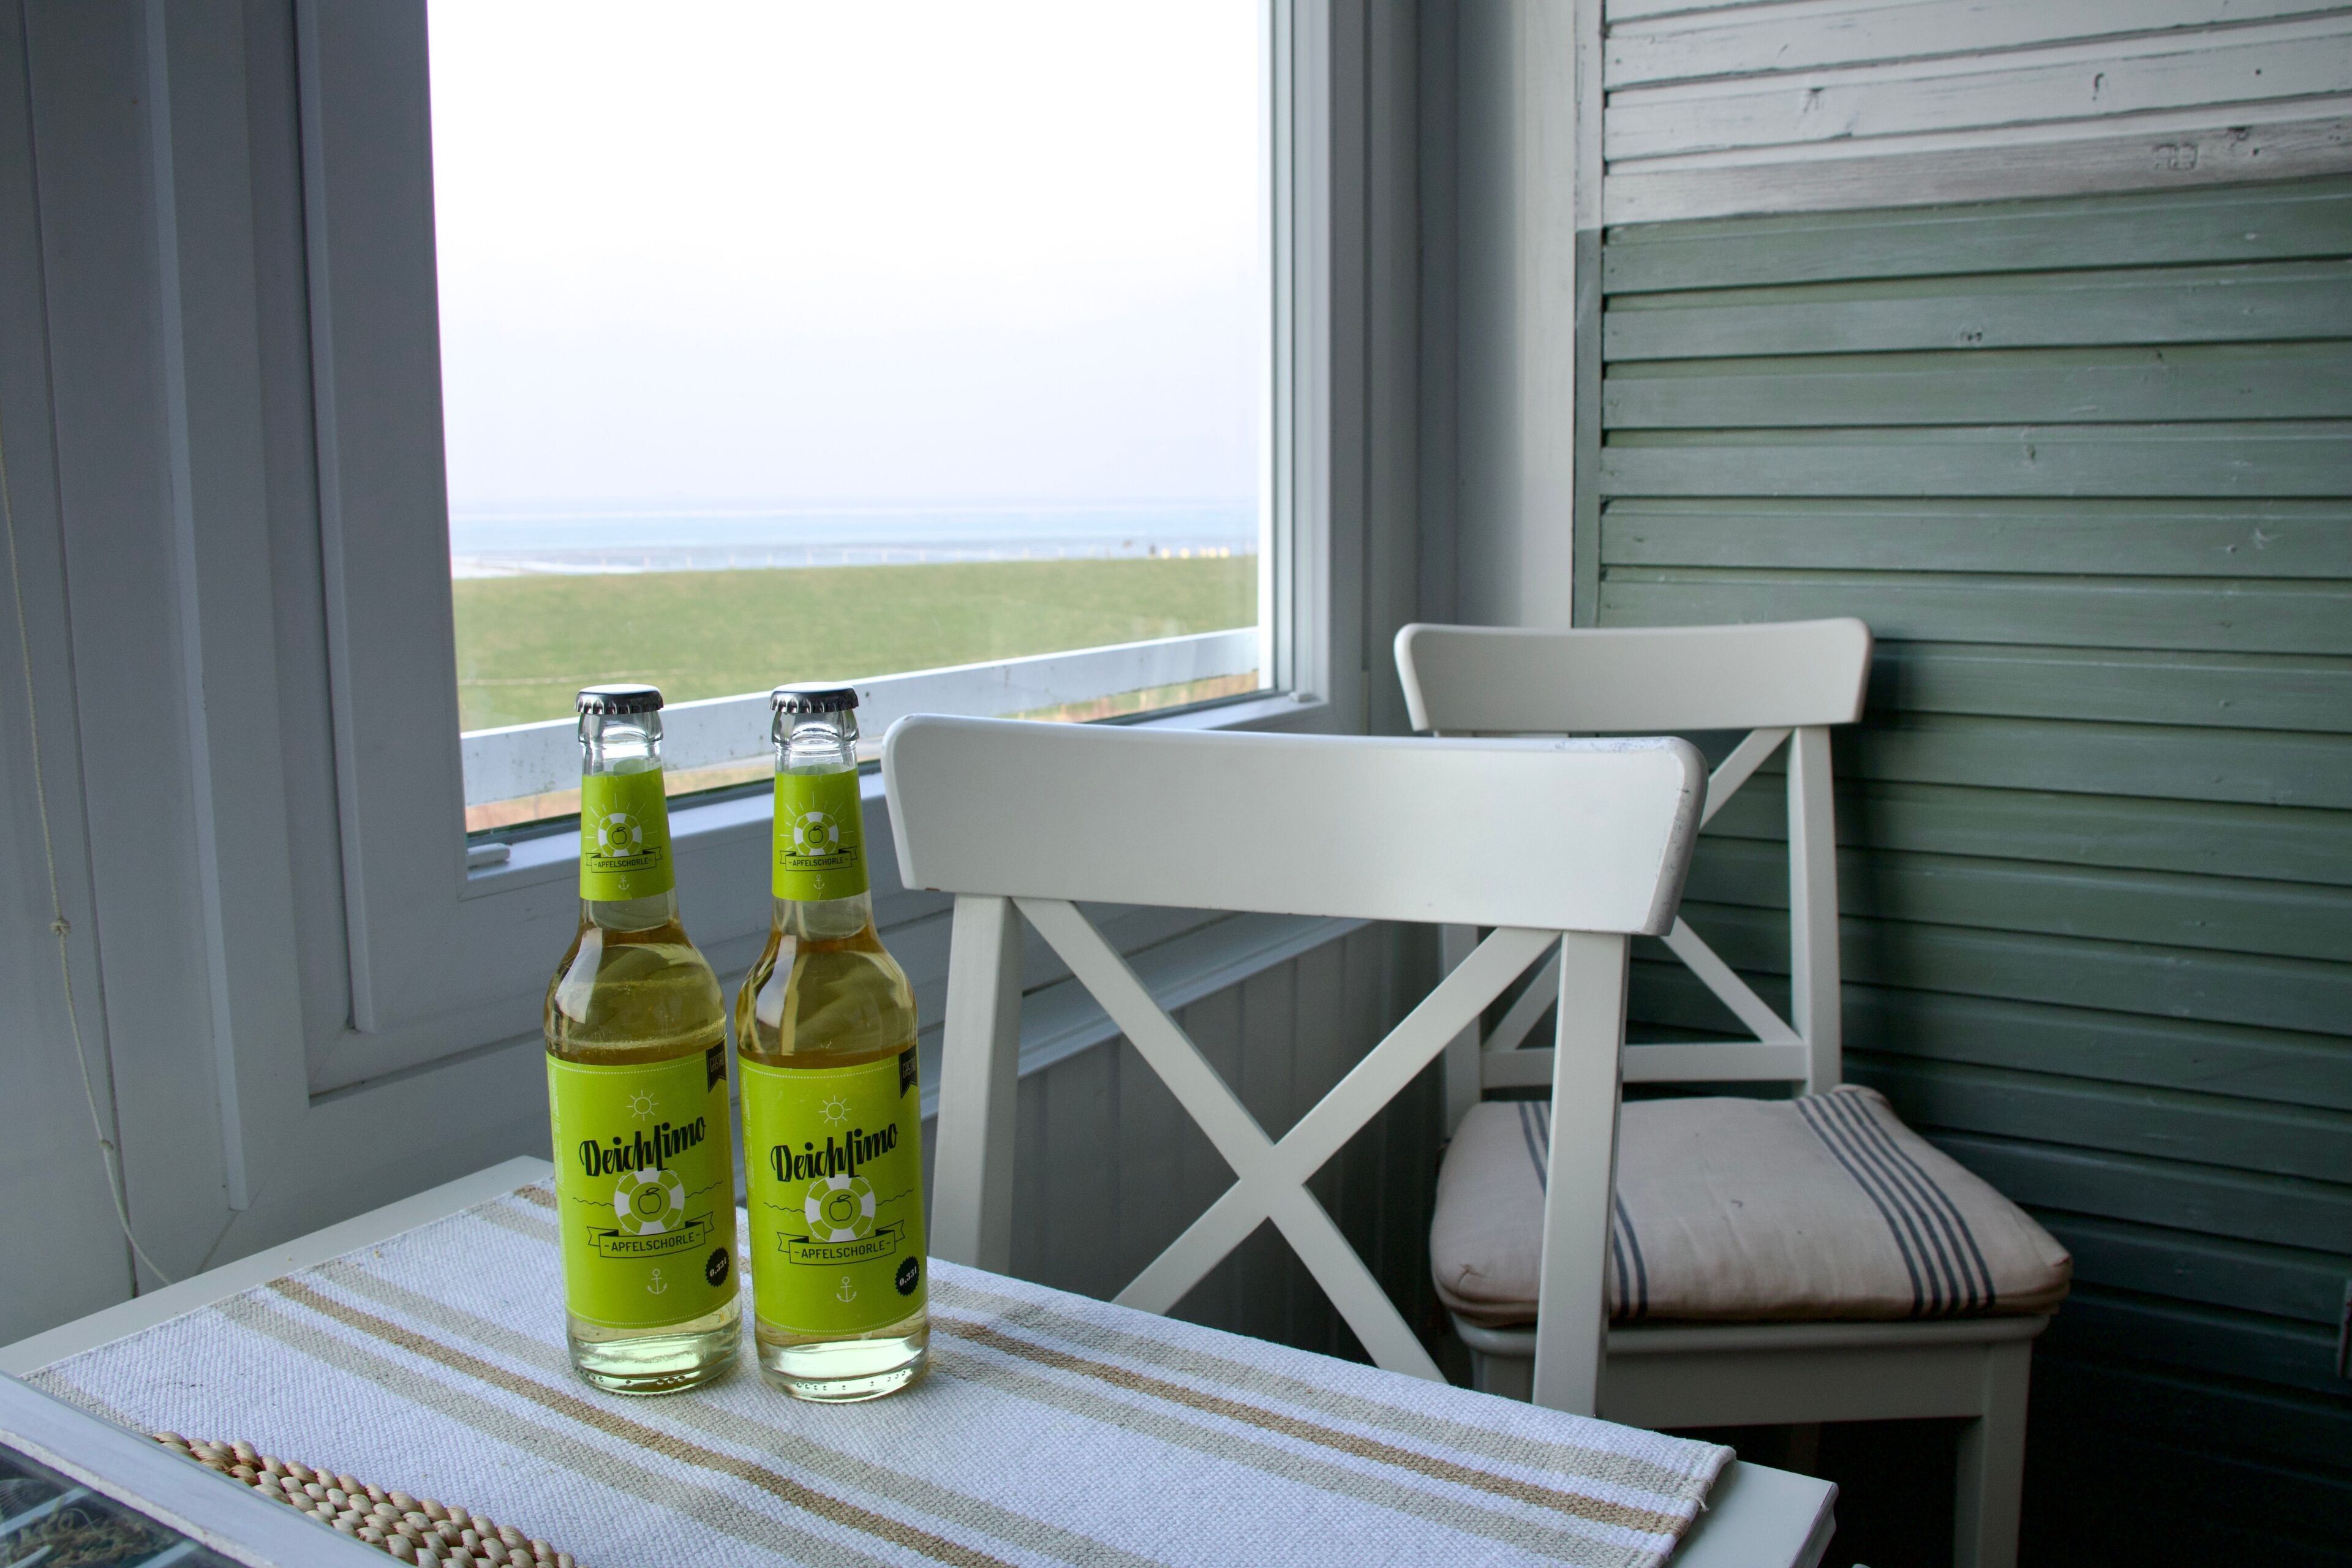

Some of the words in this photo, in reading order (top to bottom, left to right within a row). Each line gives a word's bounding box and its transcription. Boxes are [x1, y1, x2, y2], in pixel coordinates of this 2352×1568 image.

[598, 858, 649, 868] APFELSCHORLE
[793, 856, 844, 867] APFELSCHORLE
[579, 1116, 706, 1177] Deichlimo
[770, 1123, 899, 1182] Deichlimo
[611, 1232, 695, 1252] APFELSCHORLE
[801, 1240, 885, 1259] APFELSCHORLE
